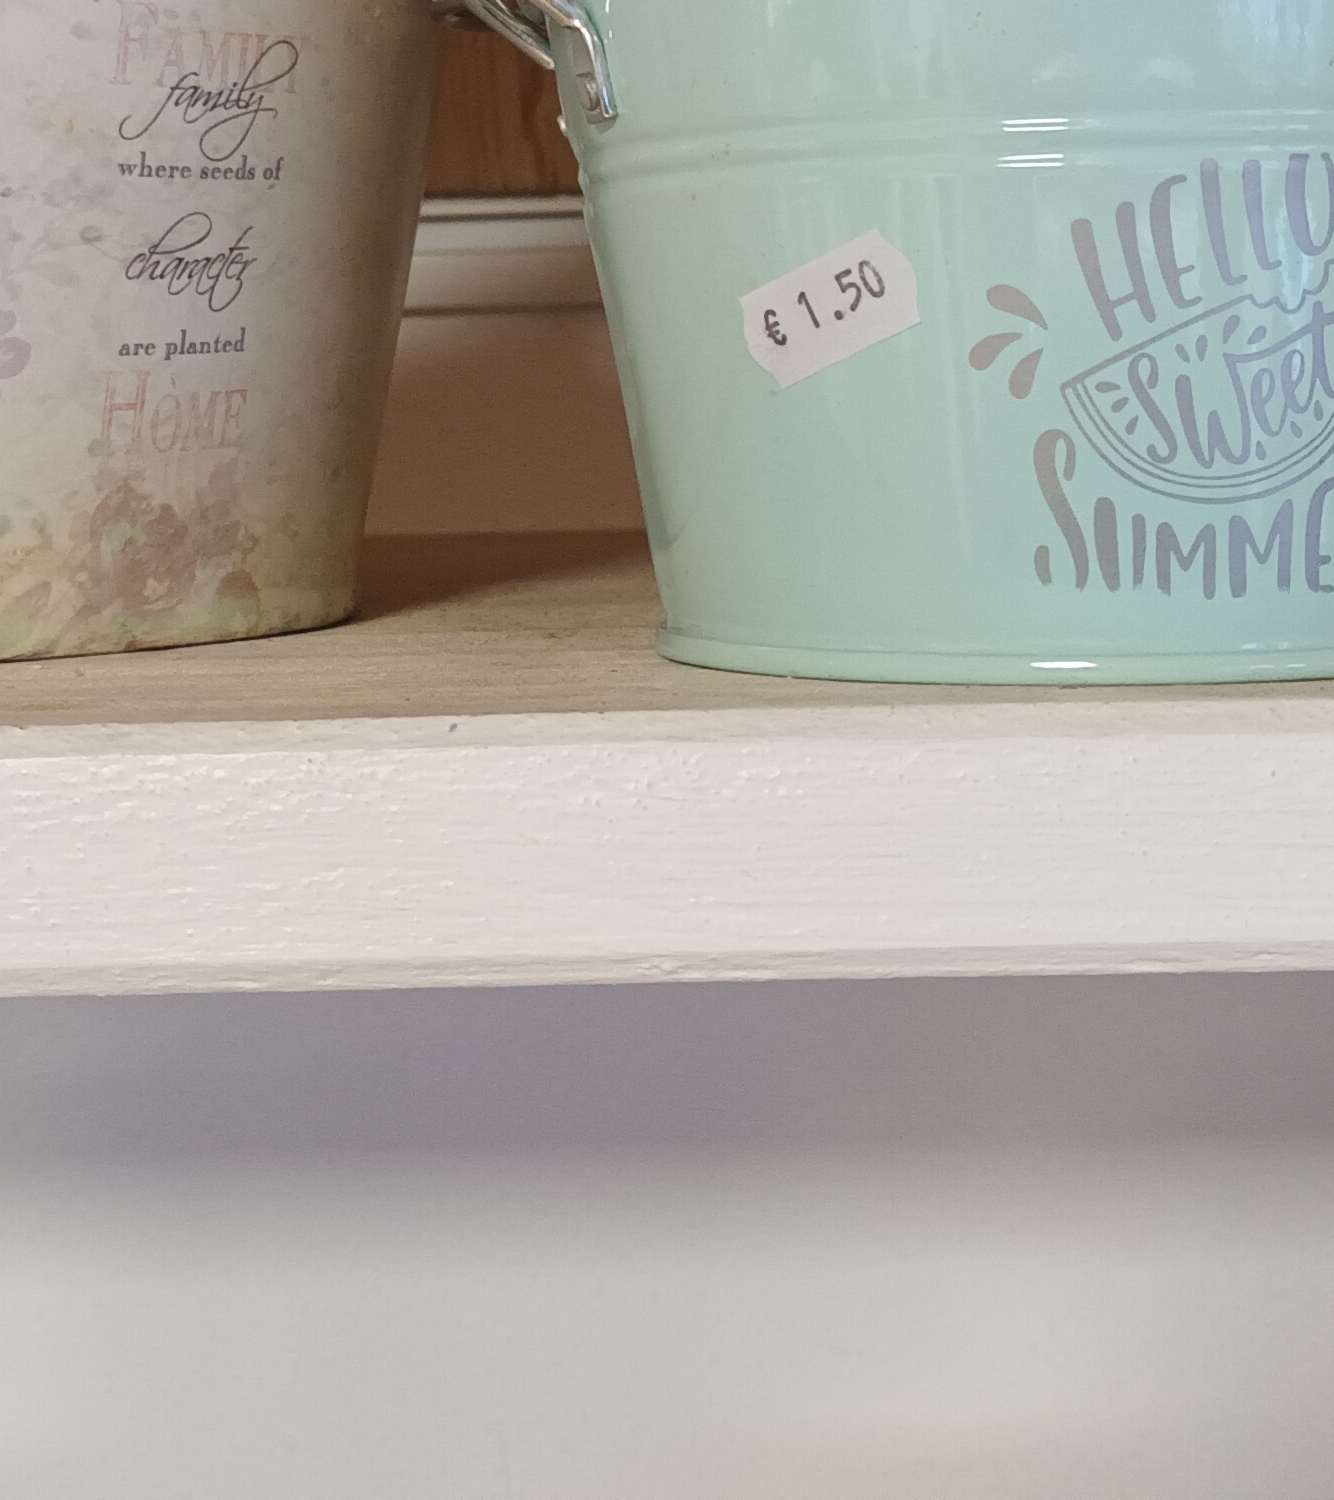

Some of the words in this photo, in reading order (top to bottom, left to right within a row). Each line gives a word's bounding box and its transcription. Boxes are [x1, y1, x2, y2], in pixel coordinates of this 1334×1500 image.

[119, 40, 299, 162] family
[118, 151, 192, 179] where
[199, 155, 256, 181] seeds
[263, 156, 285, 181] of
[125, 211, 258, 312] character
[763, 309, 787, 346] €
[797, 260, 885, 329] 1.50
[118, 341, 157, 357] are
[164, 327, 247, 361] planted
[101, 370, 250, 453] HOME
